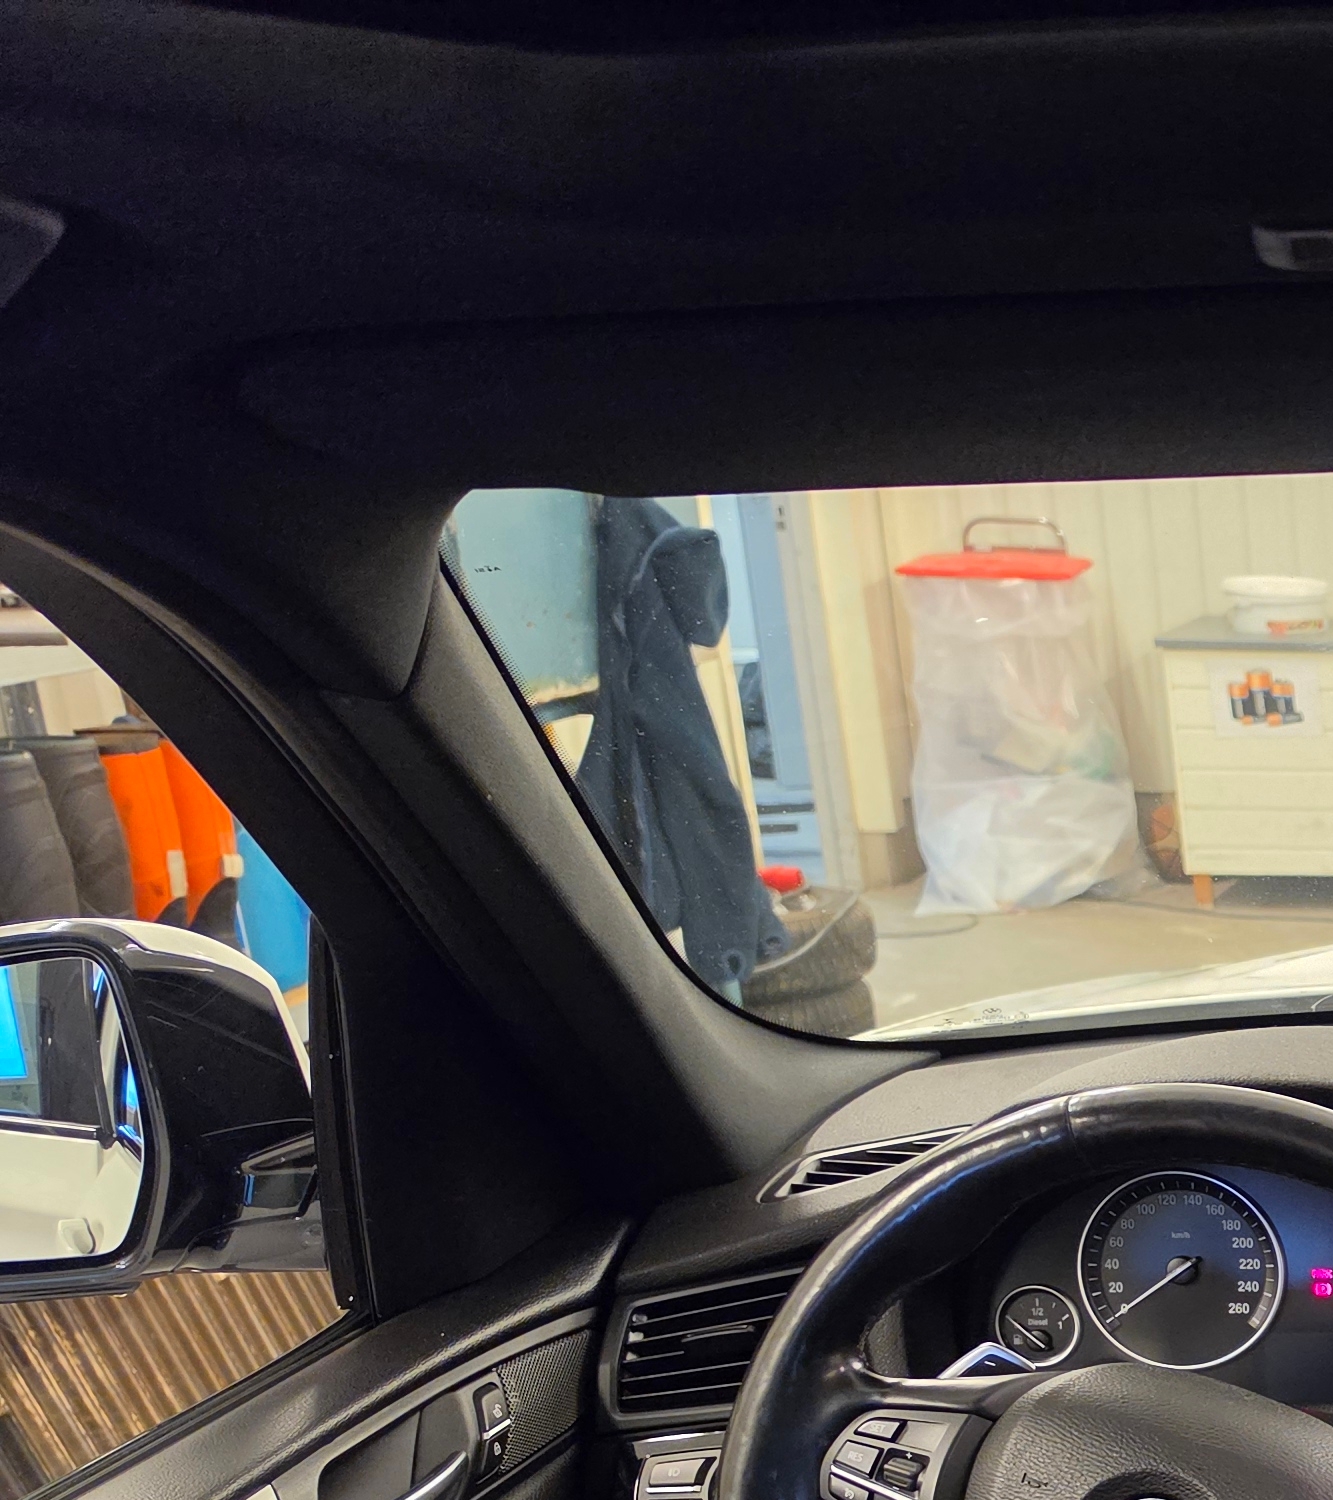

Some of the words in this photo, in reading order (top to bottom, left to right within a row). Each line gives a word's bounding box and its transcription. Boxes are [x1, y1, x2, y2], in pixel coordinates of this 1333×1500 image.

[1158, 1195, 1177, 1206] 120
[1183, 1195, 1203, 1206] 140
[1136, 1204, 1156, 1215] 100
[1206, 1205, 1225, 1216] 160
[1120, 1218, 1135, 1230] 80
[1221, 1220, 1241, 1231] 180
[1109, 1237, 1124, 1248] 60
[1232, 1237, 1254, 1249] 200
[1104, 1258, 1120, 1270] 40
[1239, 1258, 1261, 1270] 220
[1108, 1281, 1124, 1294] 20
[1237, 1280, 1260, 1293] 240
[1228, 1303, 1250, 1315] 260
[869, 1424, 887, 1433] SET
[847, 1450, 864, 1462] RES
